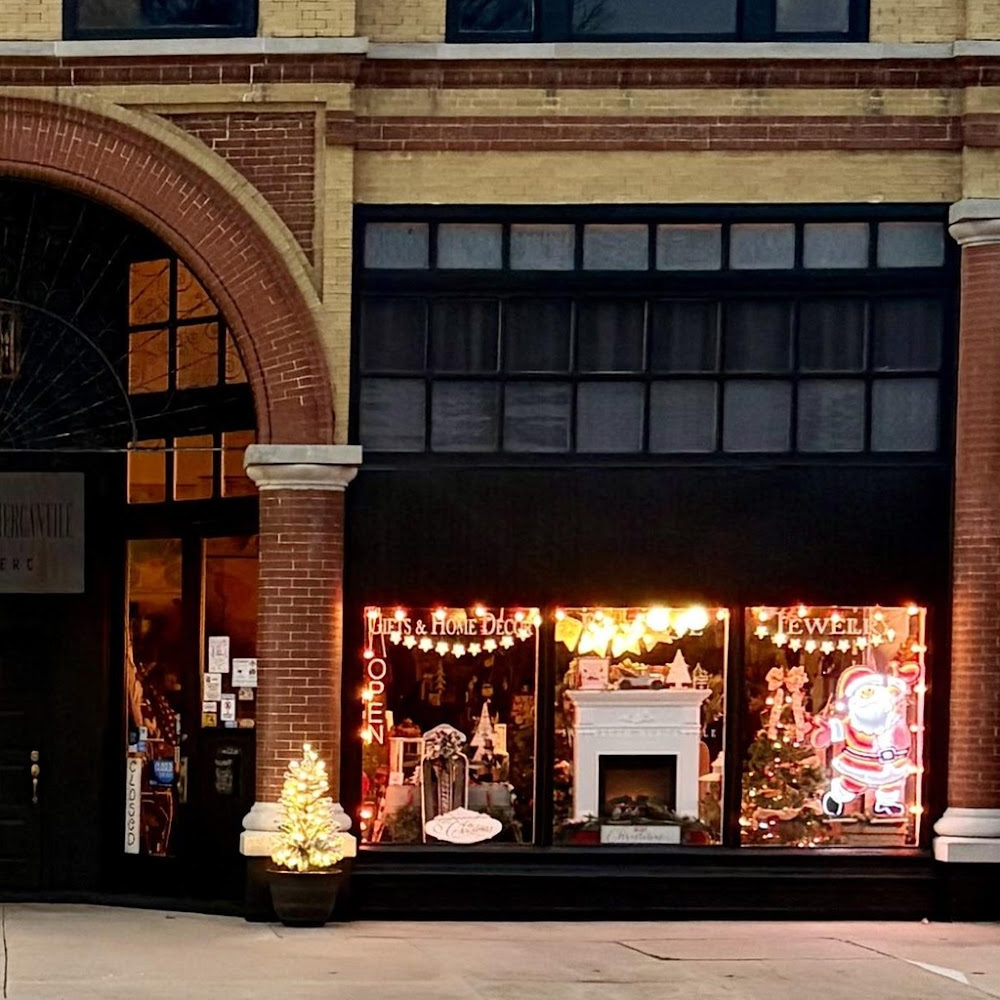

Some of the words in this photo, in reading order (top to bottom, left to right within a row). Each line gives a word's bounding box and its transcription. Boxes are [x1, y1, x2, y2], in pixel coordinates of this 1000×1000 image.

[415, 619, 428, 635] &
[431, 612, 478, 636] HOME
[367, 658, 387, 745] OPEN
